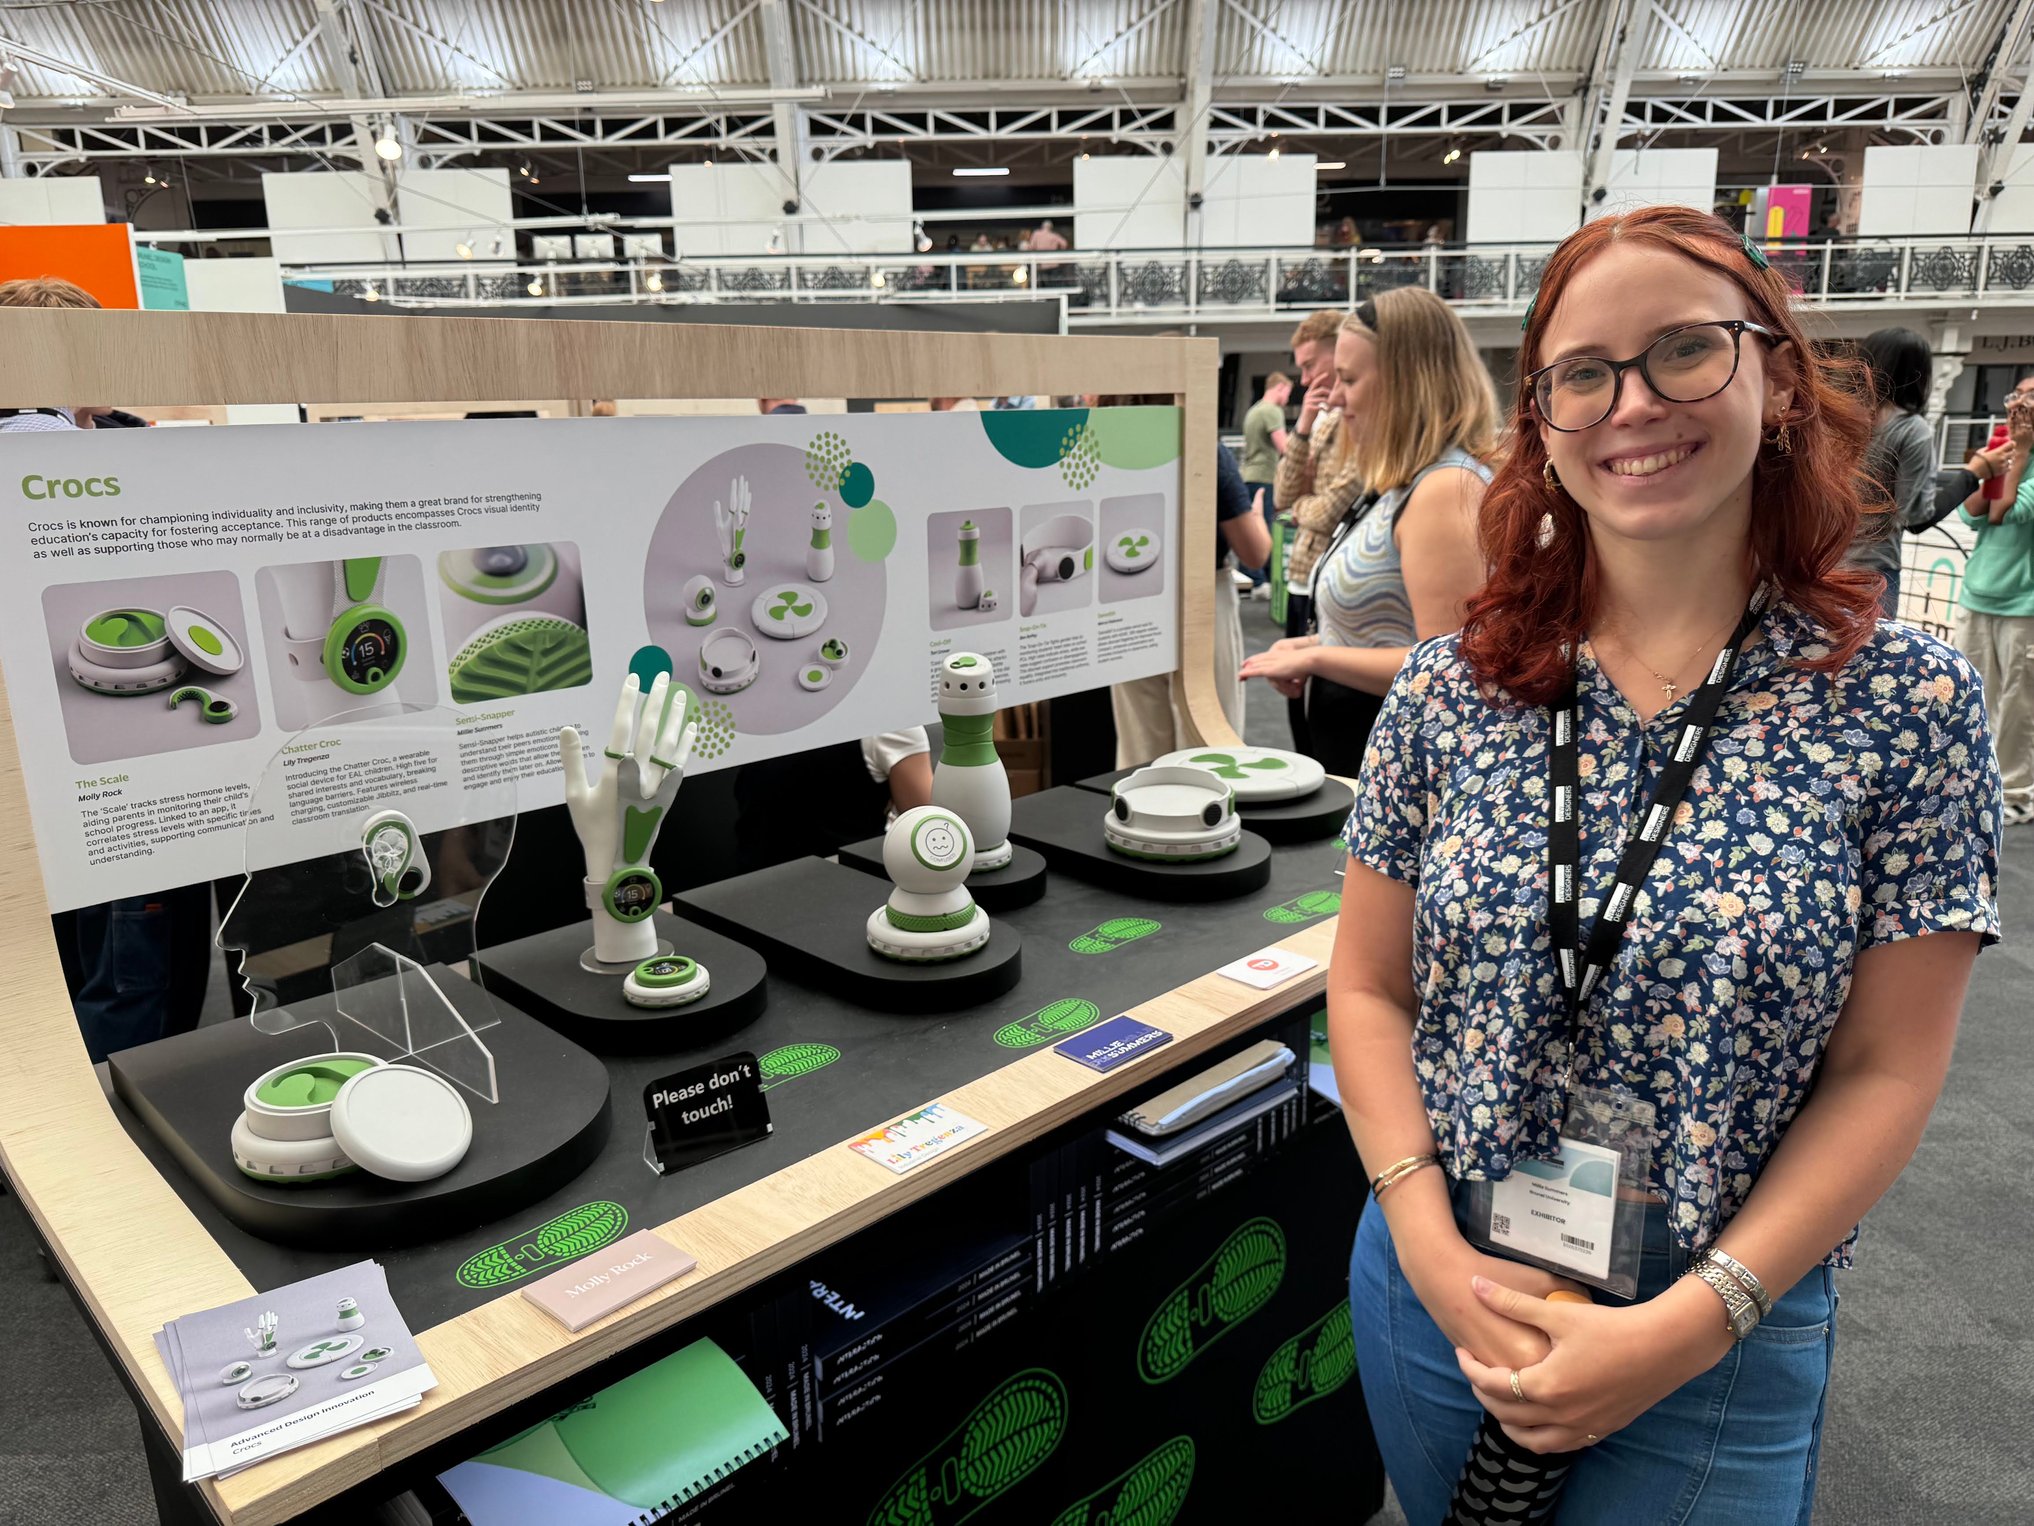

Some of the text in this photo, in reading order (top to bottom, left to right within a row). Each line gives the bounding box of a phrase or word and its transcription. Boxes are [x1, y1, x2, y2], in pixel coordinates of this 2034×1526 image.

[21, 473, 121, 501] Crocs
[28, 522, 63, 531] Crocs
[66, 520, 76, 529] is
[79, 519, 118, 528] known
[120, 516, 136, 526] for
[139, 512, 209, 525] championing
[211, 508, 272, 520] individuality
[276, 506, 294, 516] and
[296, 504, 347, 514] inclusivity,
[349, 502, 383, 511] making
[385, 500, 408, 509] them
[418, 498, 441, 508] great
[443, 496, 468, 505] brand
[470, 495, 482, 503] for
[485, 492, 541, 503] strengthening
[30, 532, 98, 545] education's
[101, 529, 148, 541] capacity
[151, 527, 167, 536] for
[170, 524, 218, 535] fostering
[221, 521, 283, 532] acceptance.
[285, 518, 307, 527] This
[309, 518, 337, 526] range
[339, 515, 348, 524] of
[351, 513, 392, 525] products
[395, 510, 455, 520] encompasses
[484, 504, 508, 513] visual
[509, 503, 540, 512] identity
[33, 550, 47, 558] as
[50, 547, 74, 557] well
[94, 541, 154, 555] supporting
[156, 540, 187, 549] those
[190, 537, 213, 546] who
[216, 536, 237, 545] may
[241, 532, 283, 543] normally
[286, 531, 299, 539] be
[302, 530, 312, 538] at
[322, 526, 385, 537] disadvantage
[387, 523, 396, 532] in
[397, 523, 412, 531] the
[414, 520, 461, 530] classroom.
[359, 642, 374, 658] 15
[456, 710, 515, 725] Sensi-Snapper
[282, 739, 342, 754] Chatter Croc
[297, 754, 330, 764] Tregenza
[1684, 726, 1704, 762] DESIGNERS
[76, 774, 129, 789] The Scale
[78, 789, 123, 802] Molly Rock
[81, 810, 98, 818] The
[130, 799, 157, 809] tracks
[159, 794, 184, 804] stress
[187, 788, 222, 799] hormone
[224, 783, 249, 792] levels,
[83, 818, 110, 827] aiding
[112, 811, 145, 824] parents
[157, 801, 201, 814] monitoring
[203, 796, 221, 805] their
[84, 825, 114, 837] school
[115, 819, 156, 833] progress.
[158, 812, 186, 823] Linked
[211, 806, 230, 814] app,
[86, 833, 130, 846] correlates
[132, 828, 159, 837] stress
[160, 822, 185, 832] levels
[186, 818, 204, 827] with
[206, 812, 238, 824] specific
[88, 846, 105, 856] and
[107, 840, 148, 852] activities,
[150, 830, 195, 844] supporting
[259, 814, 274, 822] and
[1650, 805, 1670, 842] DESIGNERS
[89, 848, 154, 865] understanding.
[1613, 885, 1634, 922] DESIGNERS
[1086, 1040, 1124, 1059] MILLIE
[1108, 1030, 1162, 1058] SUMMERS
[652, 1064, 752, 1109] Please don't
[681, 1094, 733, 1124] touch!
[887, 1152, 912, 1164] Lily
[910, 1125, 964, 1152] Tregenza
[1531, 1209, 1566, 1225] EXHIBITOR
[564, 1252, 654, 1298] Molly Rock
[230, 1390, 375, 1448] Advanced Design Innovation
[232, 1440, 262, 1455] Crocs
